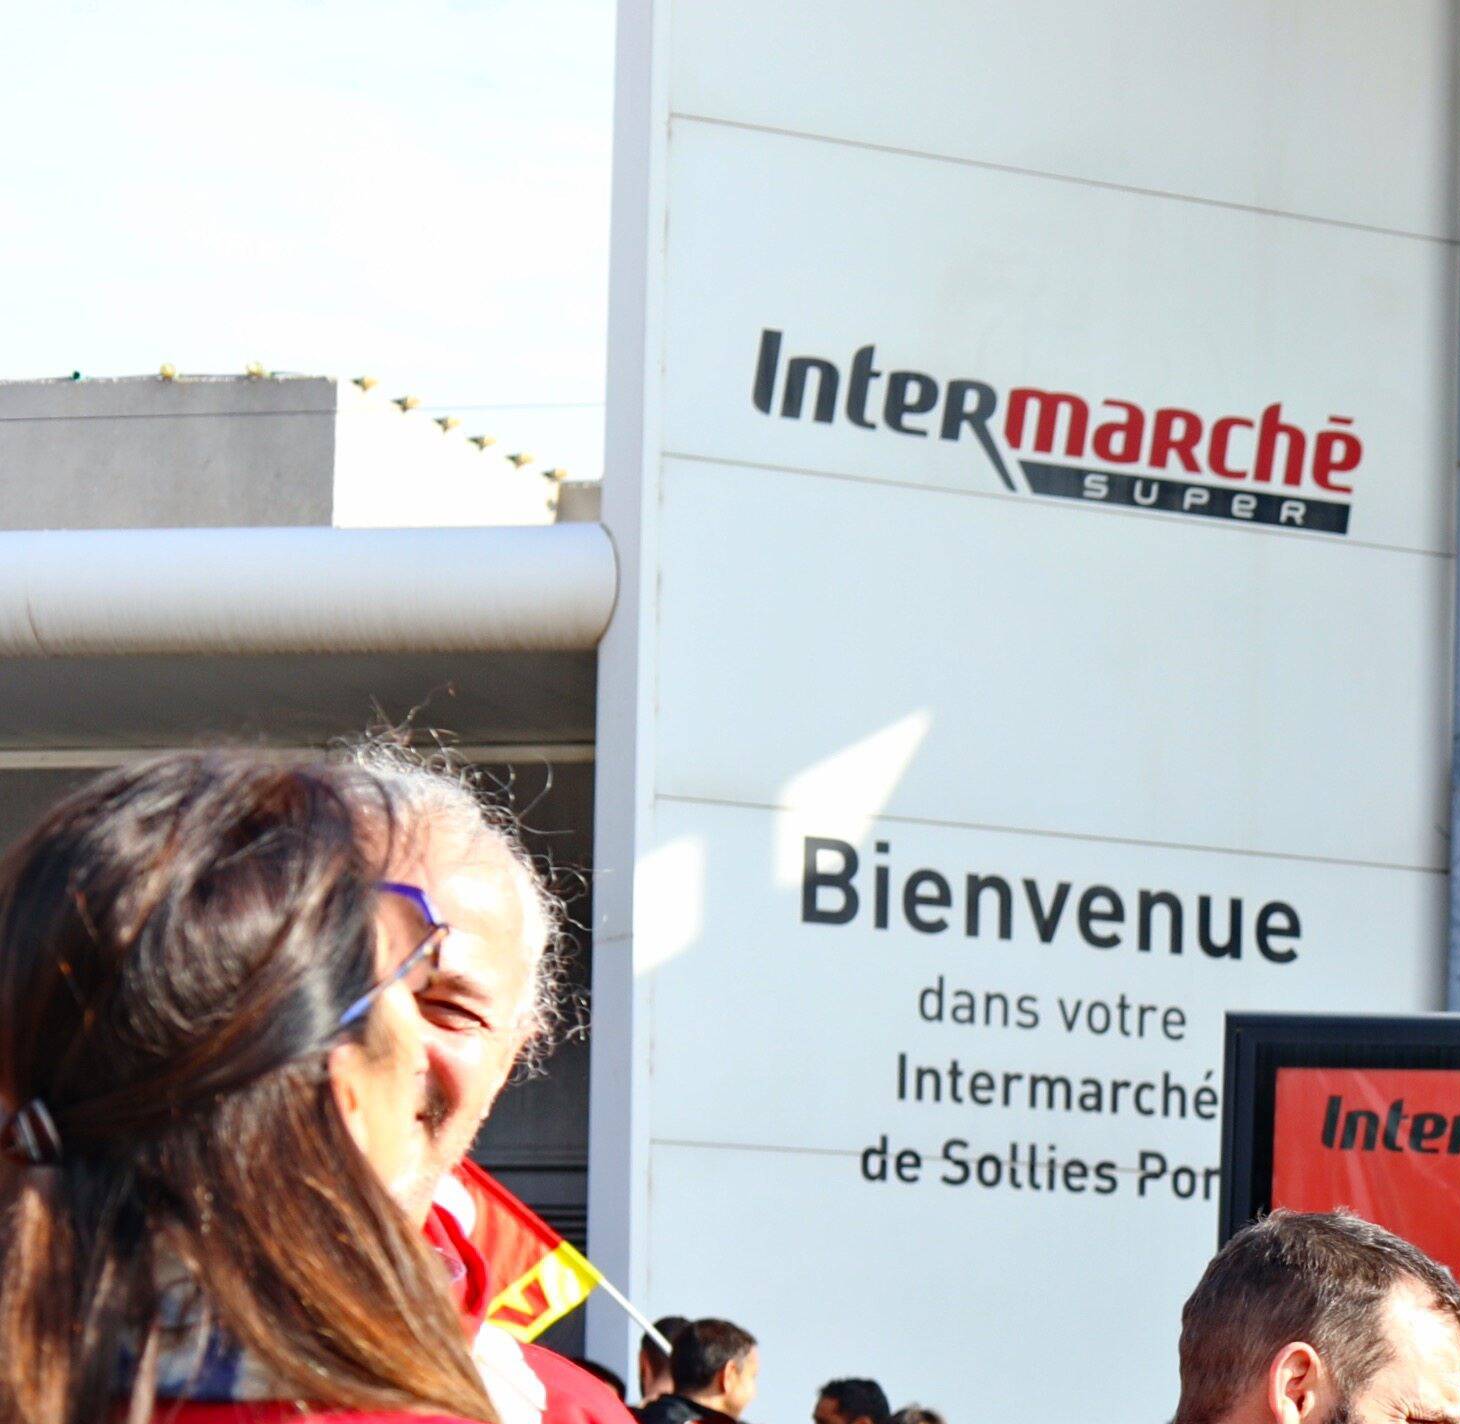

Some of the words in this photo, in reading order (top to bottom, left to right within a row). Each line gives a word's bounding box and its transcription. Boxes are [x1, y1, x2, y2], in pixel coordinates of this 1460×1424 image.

[1083, 471, 1307, 526] SUPER
[801, 835, 1302, 964] Bienvenue
[919, 975, 1040, 1029] dans
[1058, 993, 1187, 1042] votre
[897, 1053, 1218, 1122] Intermarché
[861, 1136, 922, 1184] de
[941, 1138, 1119, 1195] Sollies
